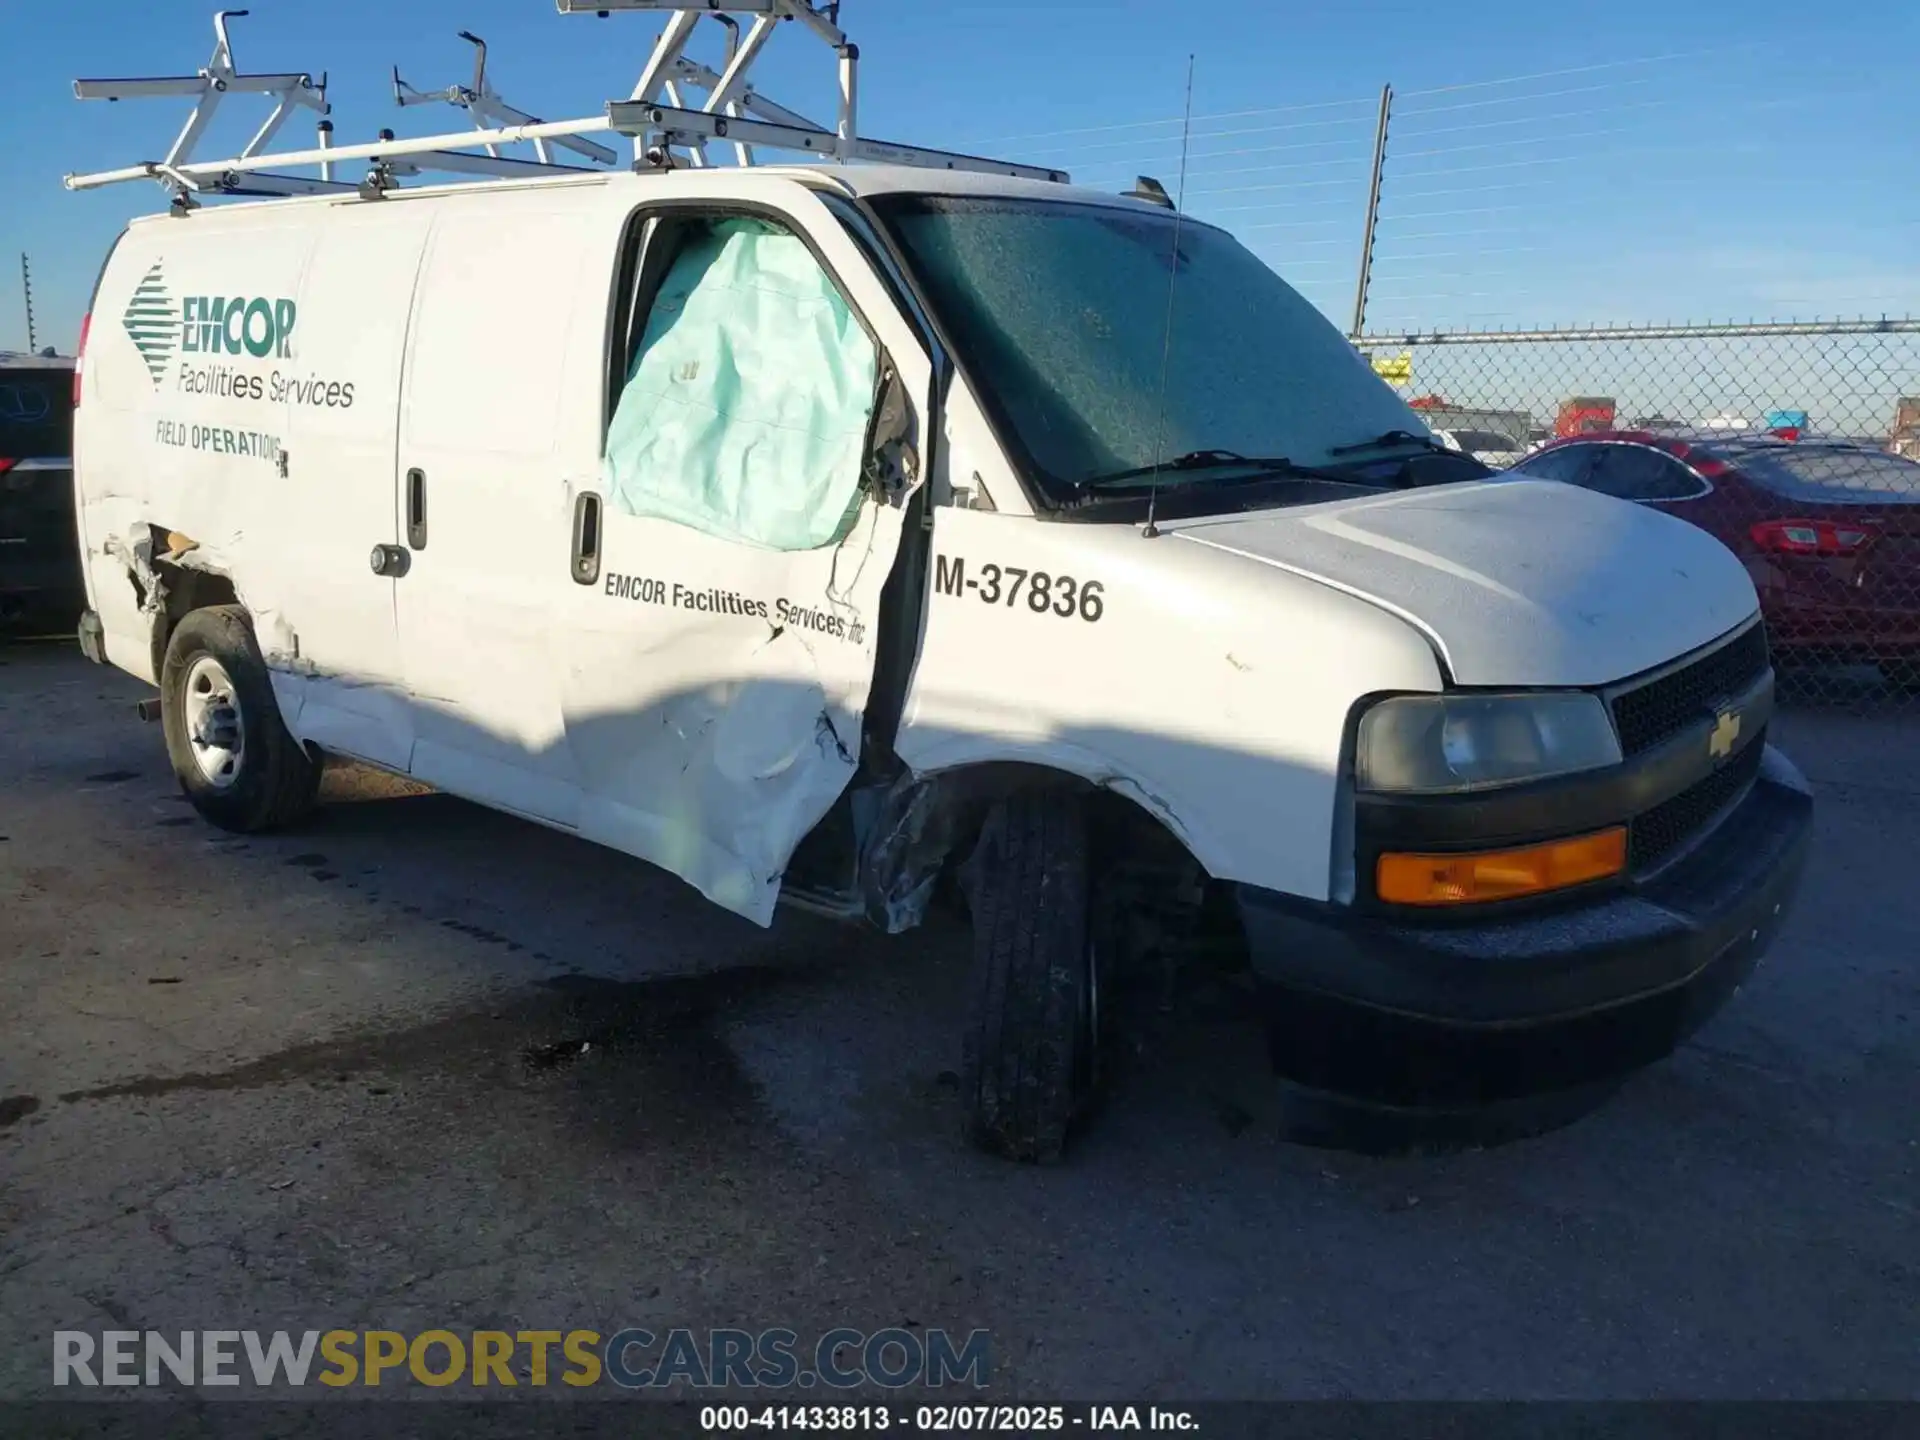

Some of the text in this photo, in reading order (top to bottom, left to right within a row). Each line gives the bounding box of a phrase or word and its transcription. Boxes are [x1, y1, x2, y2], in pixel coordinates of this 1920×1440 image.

[182, 296, 296, 358] EMCOR
[178, 363, 354, 408] Facilities Services
[157, 419, 186, 447] FIELD
[604, 572, 666, 605] EMCOR
[672, 583, 768, 618] Facilities
[935, 554, 1104, 622] M-37836
